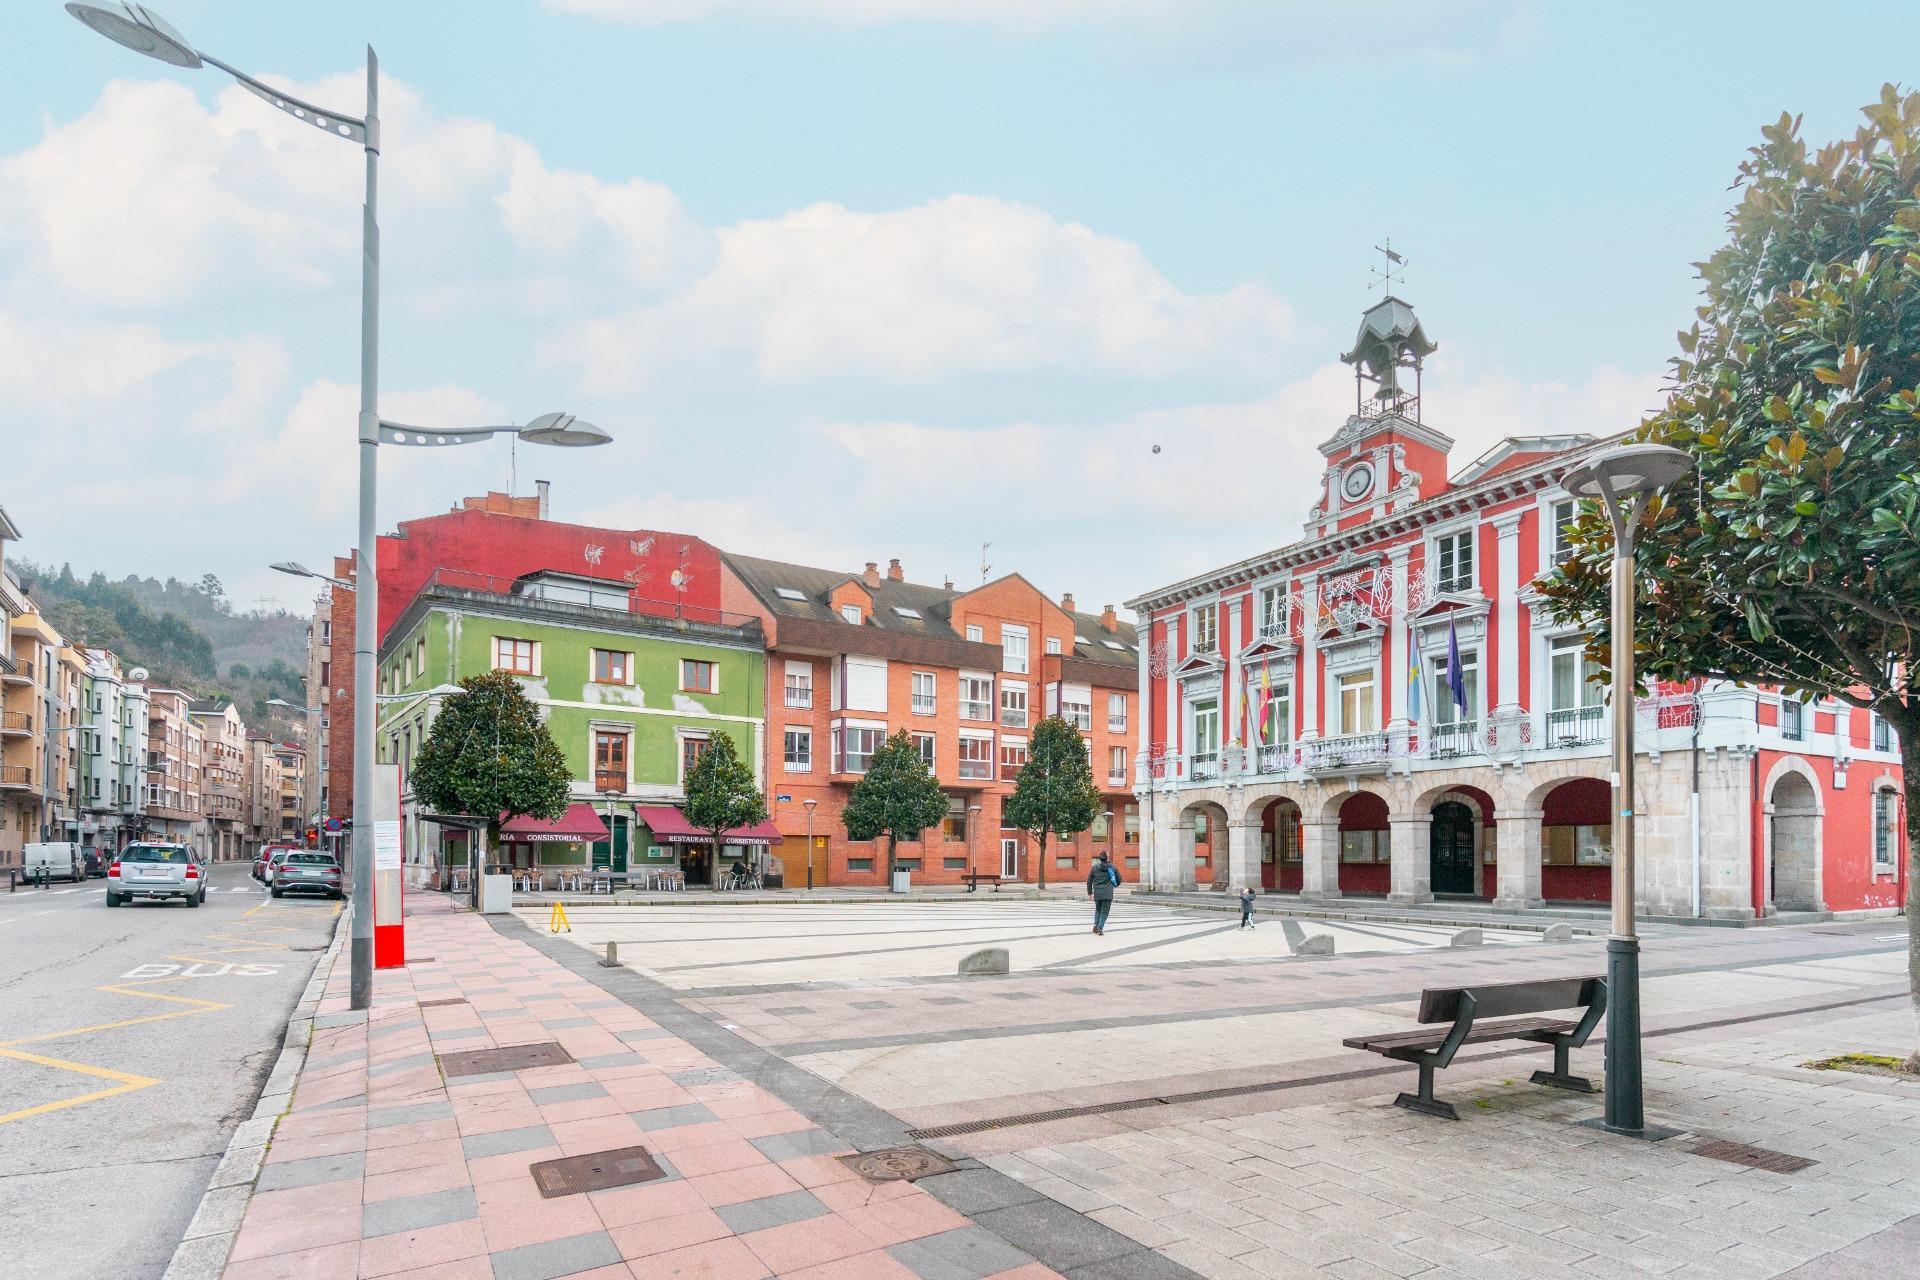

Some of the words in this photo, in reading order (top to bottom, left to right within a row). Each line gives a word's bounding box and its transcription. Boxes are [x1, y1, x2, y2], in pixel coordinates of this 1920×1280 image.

[526, 834, 583, 842] CONSISTORIAL
[726, 837, 771, 845] CONSISTORIAL
[119, 963, 283, 979] BUS
